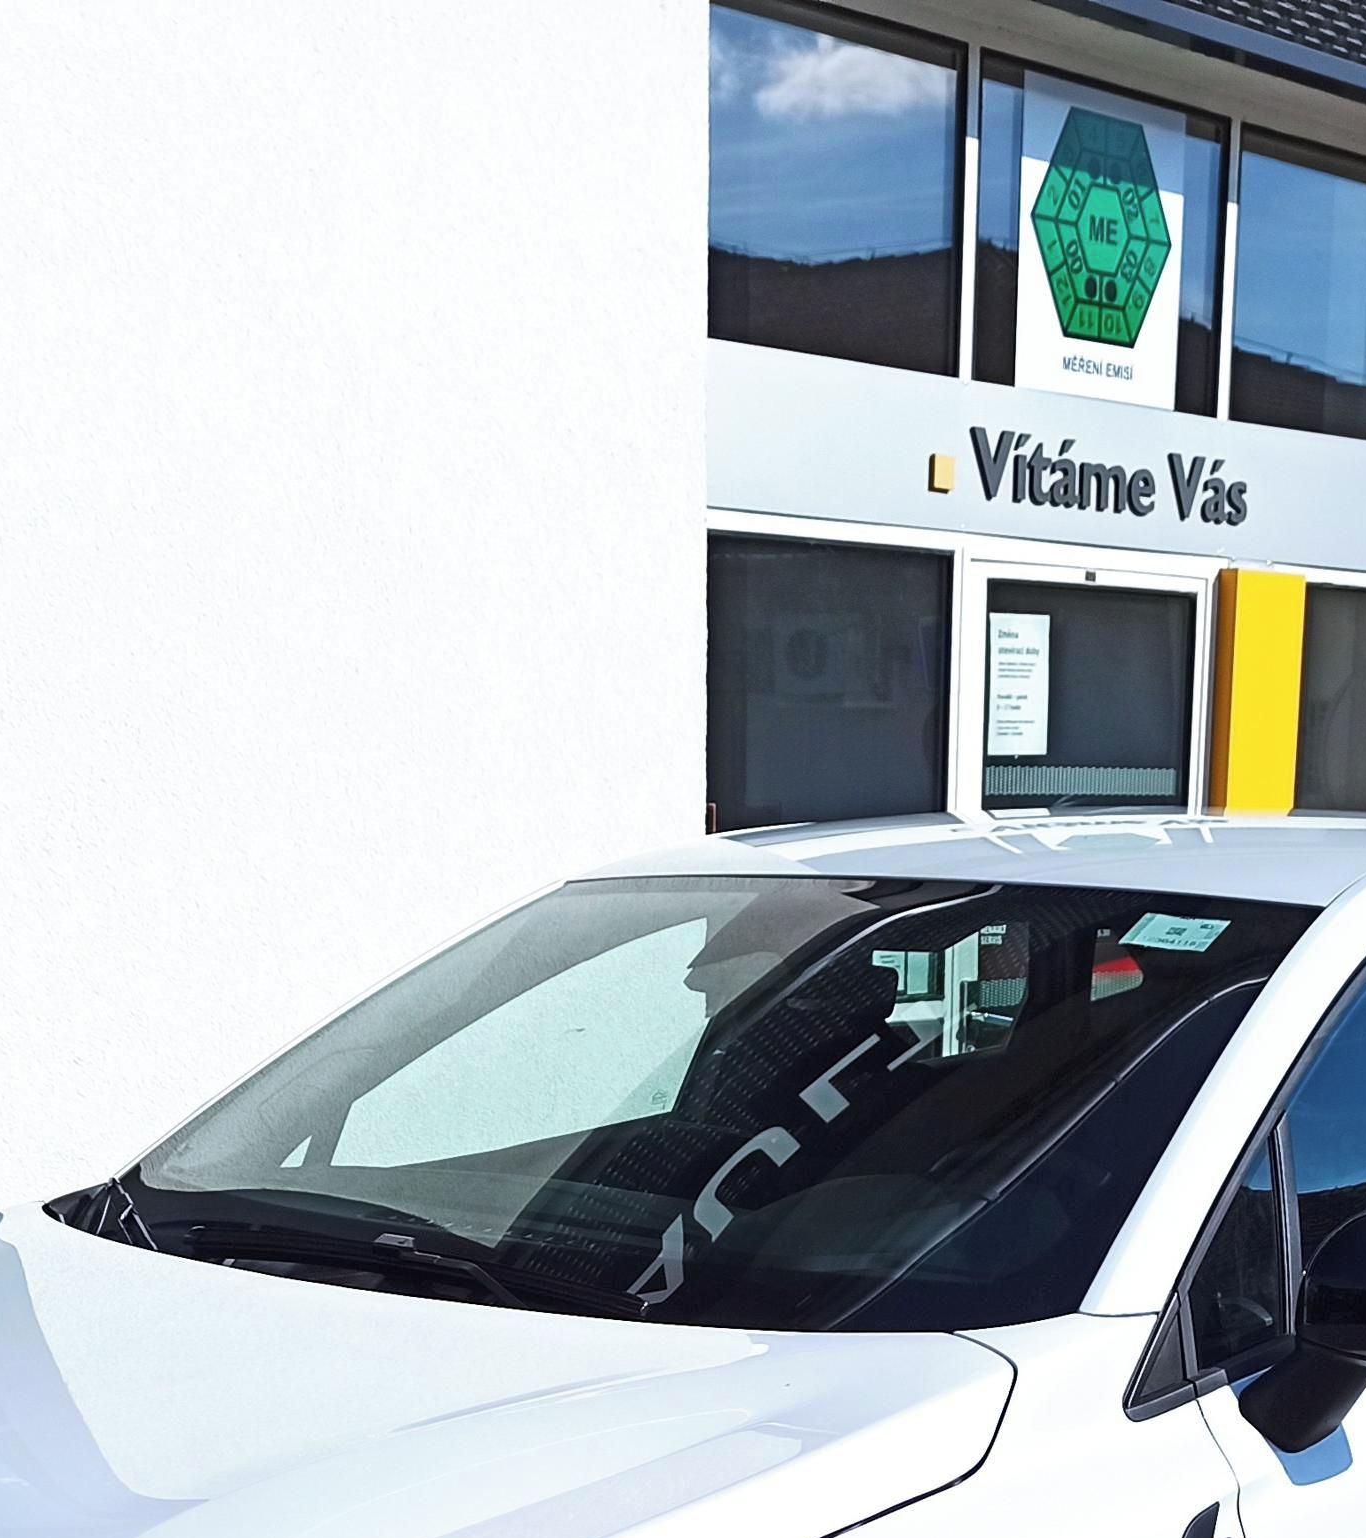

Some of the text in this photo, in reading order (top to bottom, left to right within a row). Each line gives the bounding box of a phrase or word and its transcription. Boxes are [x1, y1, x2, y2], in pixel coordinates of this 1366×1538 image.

[1089, 214, 1118, 247] ME
[969, 426, 1248, 526] Vítáme Vás
